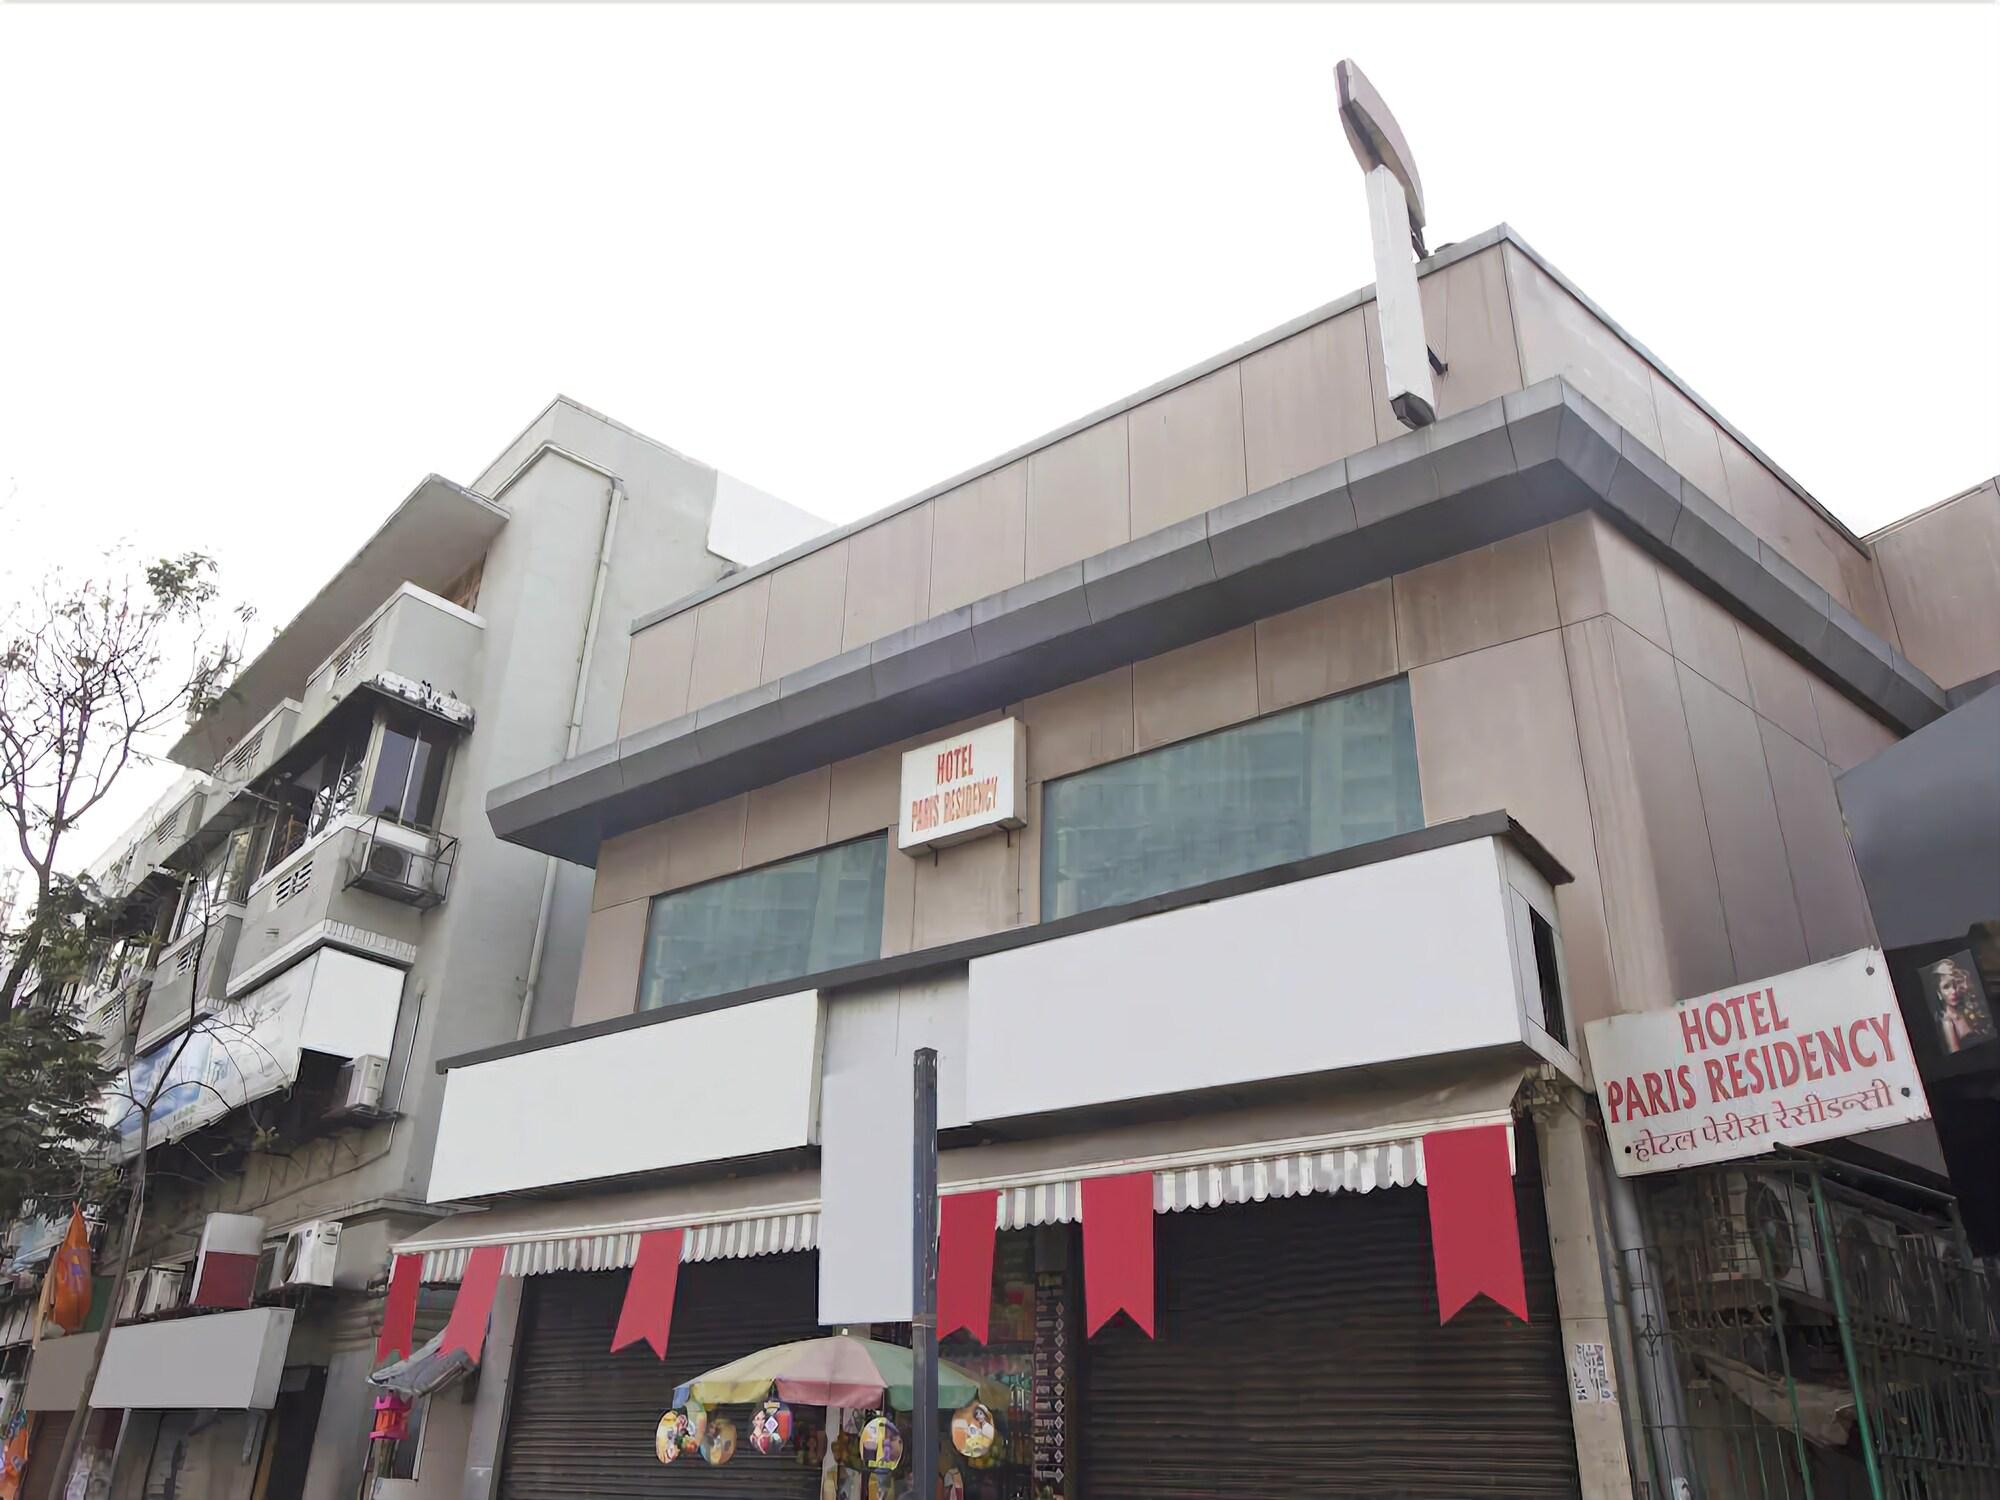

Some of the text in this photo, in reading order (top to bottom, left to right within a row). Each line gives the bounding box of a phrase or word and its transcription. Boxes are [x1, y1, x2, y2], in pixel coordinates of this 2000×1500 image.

[936, 743, 973, 785] HOTEL
[912, 775, 998, 832] PARIS RESIDENCY
[1680, 988, 1789, 1053] HOTEL
[1607, 1014, 1895, 1123] PARIS RESIDENCY
[1633, 1129, 1698, 1162] होटल
[1703, 1114, 1770, 1144] पेरीस
